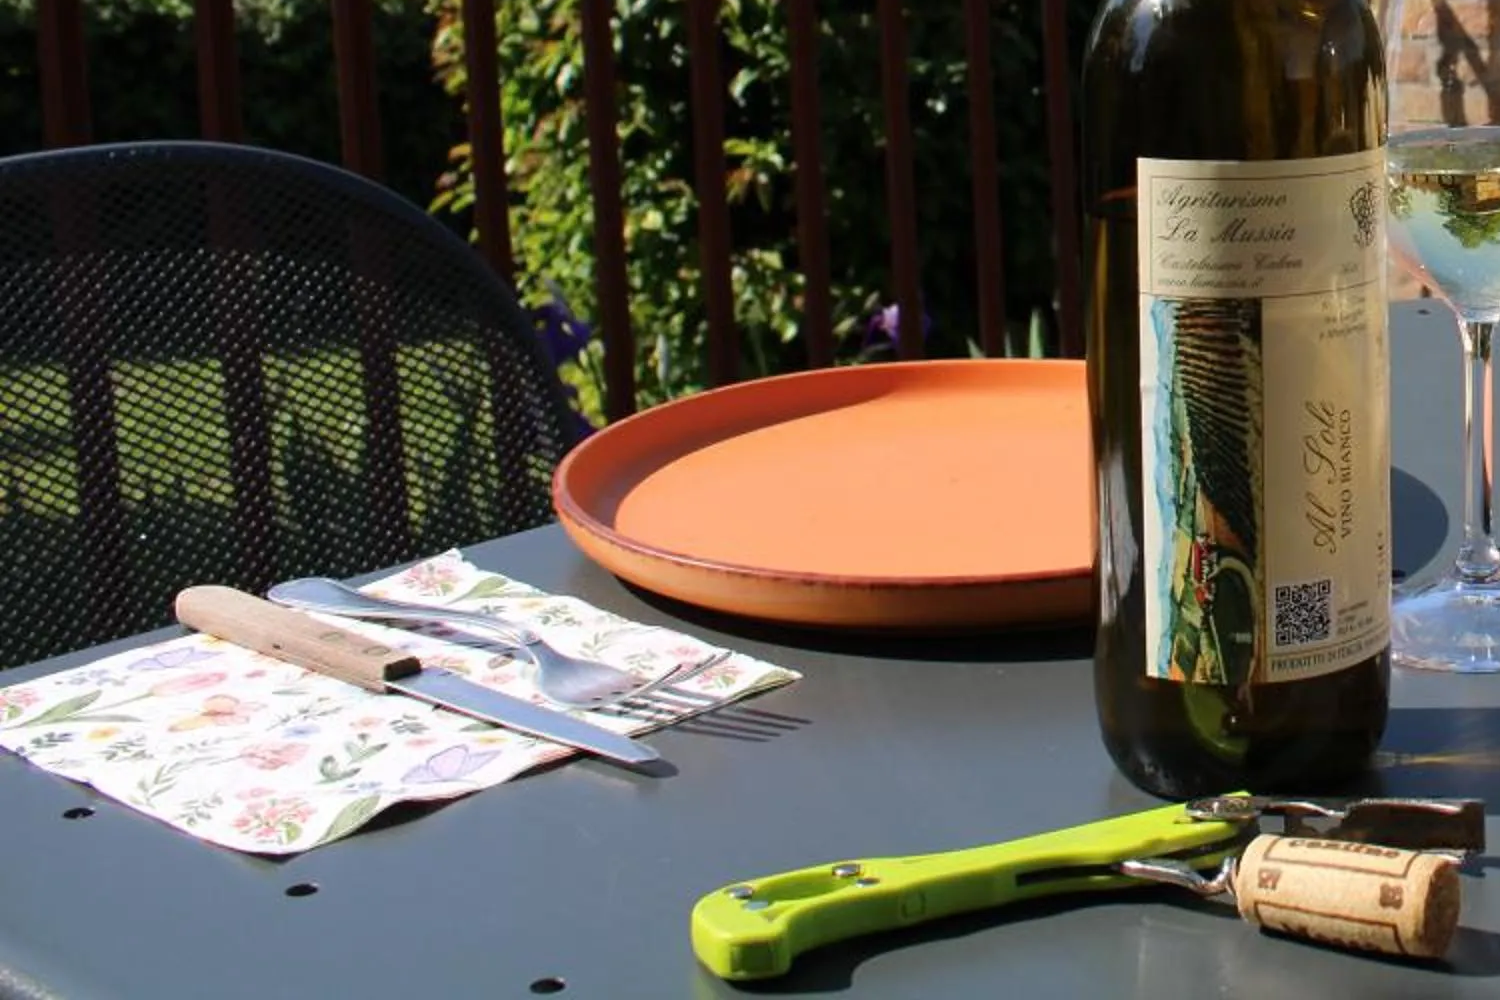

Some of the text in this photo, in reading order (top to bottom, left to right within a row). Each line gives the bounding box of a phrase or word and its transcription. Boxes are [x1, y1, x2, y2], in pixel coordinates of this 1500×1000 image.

[1156, 185, 1288, 214] Agriturismo
[1157, 215, 1296, 244] La Mussia
[1302, 399, 1337, 555] Al Sole
[1338, 409, 1353, 541] VINO BIANCO
